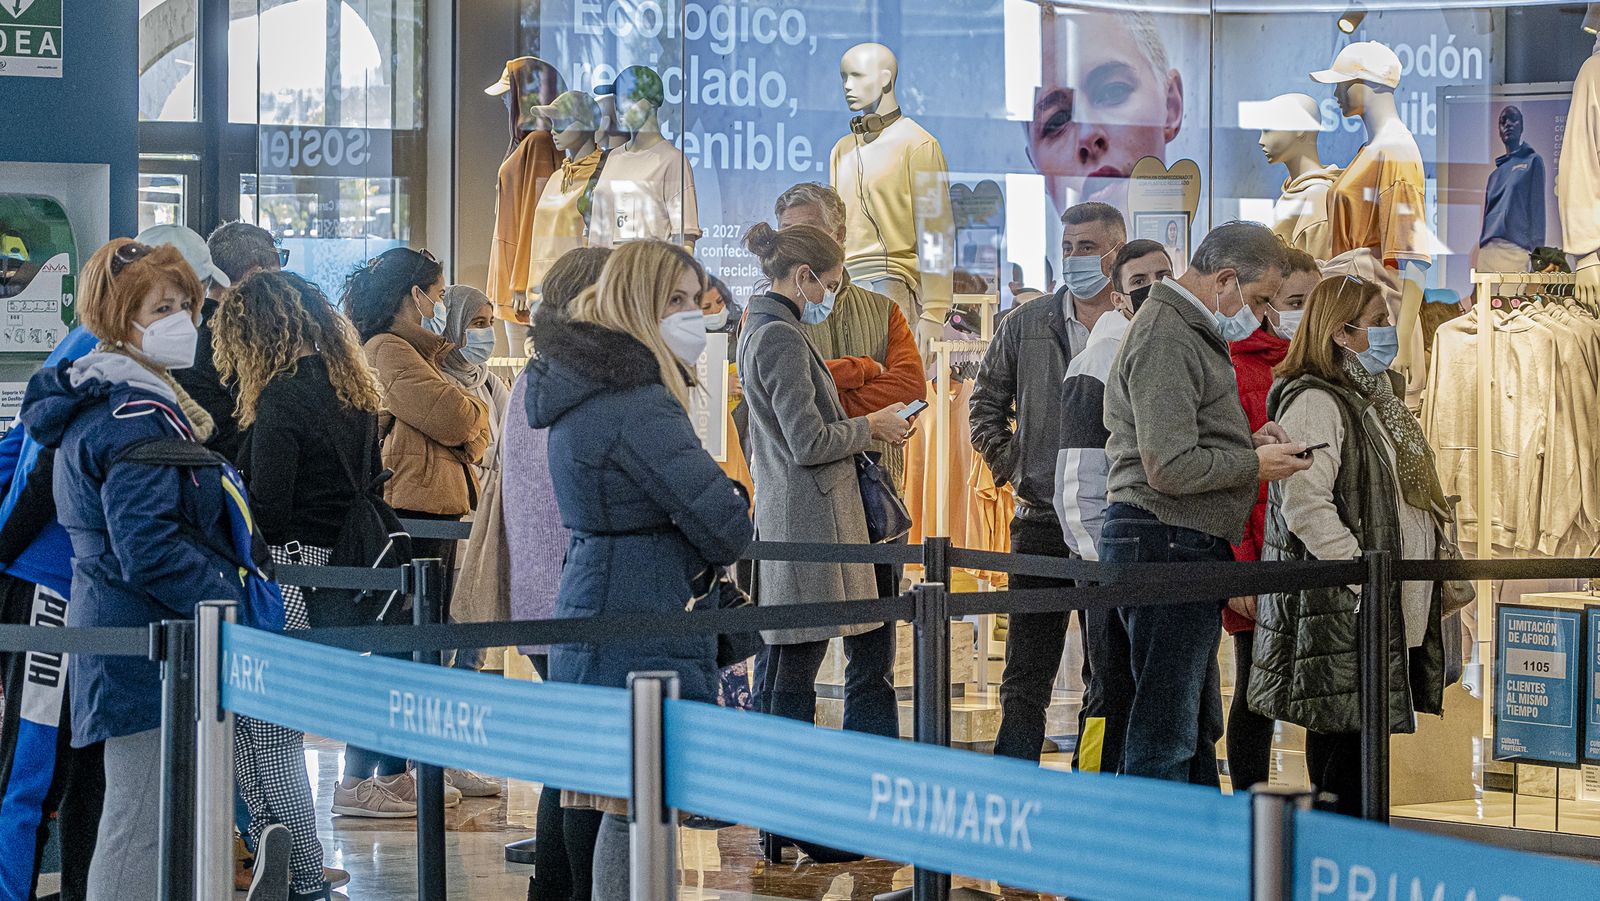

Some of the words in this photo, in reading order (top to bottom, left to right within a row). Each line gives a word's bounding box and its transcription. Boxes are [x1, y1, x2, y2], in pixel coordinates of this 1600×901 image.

[1508, 619, 1557, 634] LIMITACIÓN
[1508, 631, 1520, 643] DE
[1521, 633, 1549, 646] AFORO
[1551, 636, 1557, 646] A
[1523, 660, 1550, 673] 1105
[1506, 679, 1546, 694] CLIENTES
[1506, 692, 1517, 703] AL
[1518, 693, 1549, 707] MISMO
[389, 688, 488, 746] PRIMARK
[1506, 704, 1538, 718] TIEMPO
[868, 772, 1038, 852] PRIMARK
